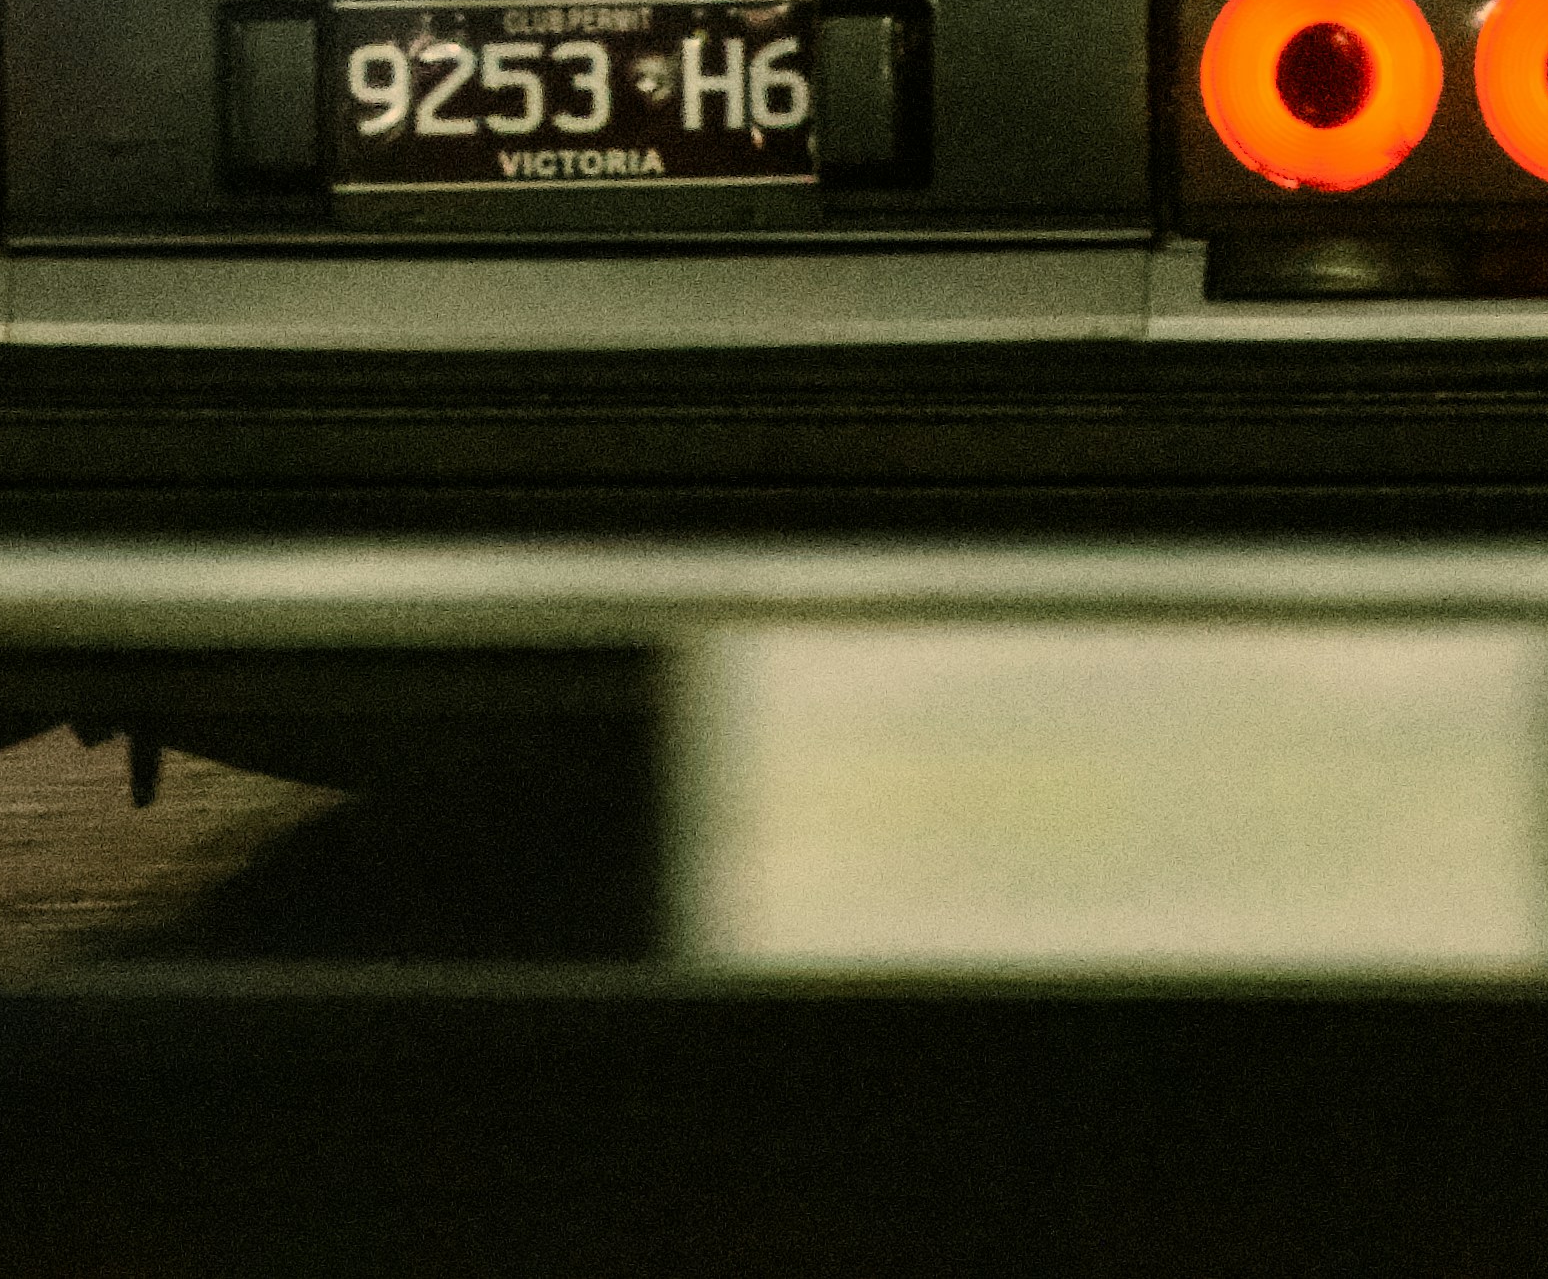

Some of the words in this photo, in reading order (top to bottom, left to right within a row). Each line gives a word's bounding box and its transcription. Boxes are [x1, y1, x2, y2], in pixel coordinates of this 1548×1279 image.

[568, 6, 652, 33] PERMIT
[347, 40, 611, 136] 9253
[681, 37, 809, 132] H6
[498, 148, 665, 180] VICTORIA
